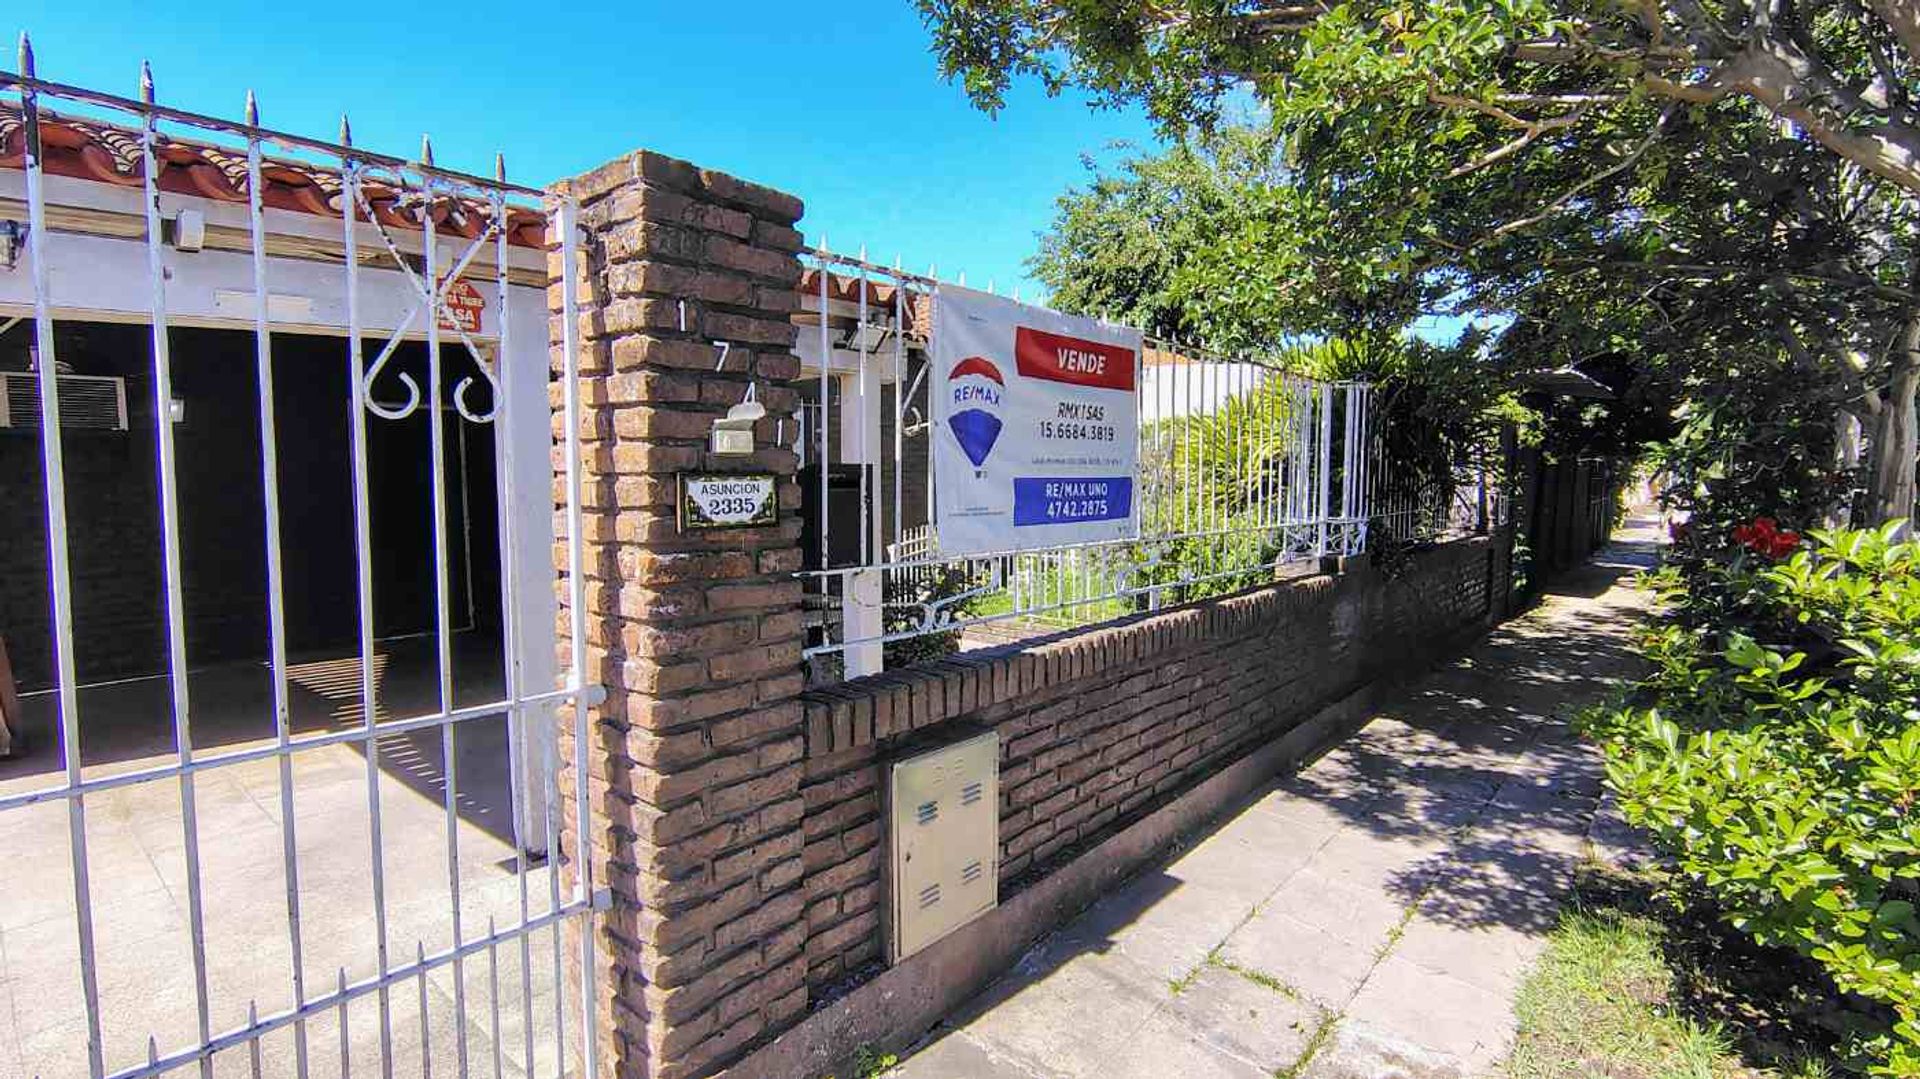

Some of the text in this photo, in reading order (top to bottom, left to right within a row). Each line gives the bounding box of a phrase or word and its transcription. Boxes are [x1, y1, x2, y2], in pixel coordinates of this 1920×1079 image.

[1057, 347, 1106, 375] VENDE
[954, 385, 1000, 406] RE/MAX
[701, 482, 760, 496] ASUNCION
[1046, 482, 1108, 498] RE/MAX UNO
[709, 498, 756, 516] 2335
[1046, 500, 1108, 519] 4742.2875
